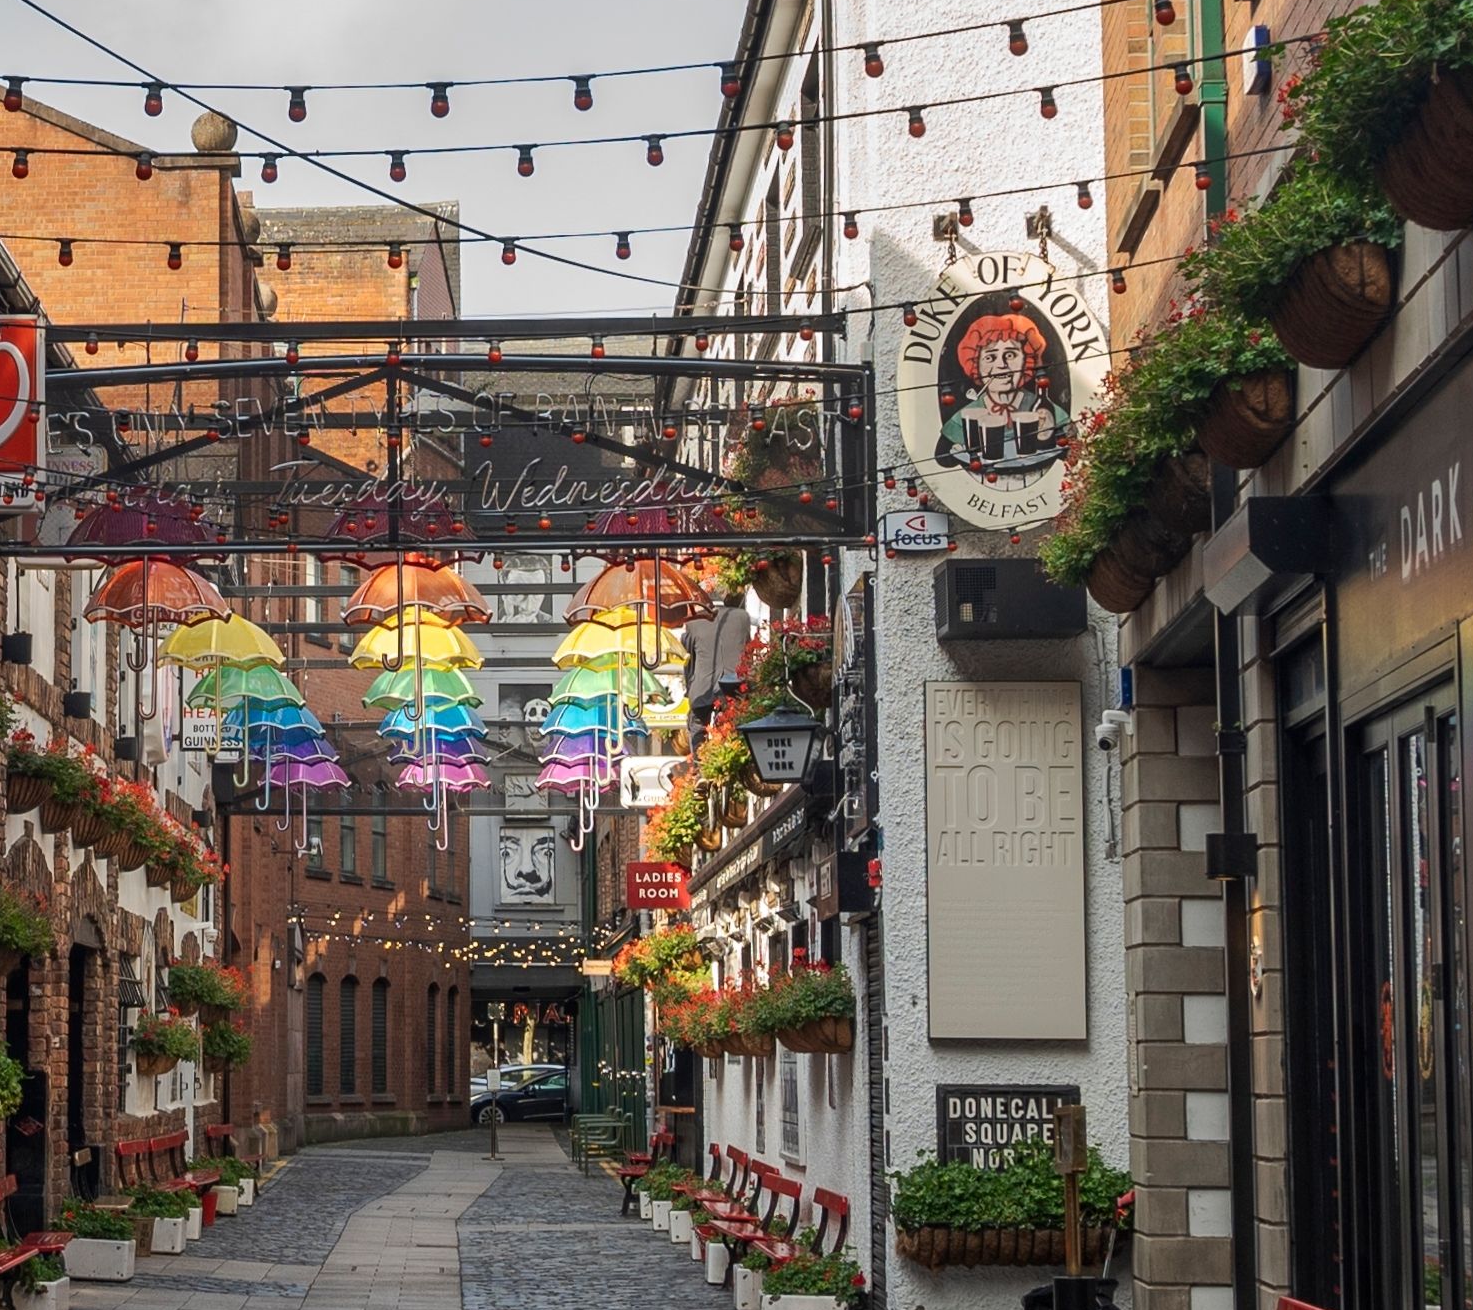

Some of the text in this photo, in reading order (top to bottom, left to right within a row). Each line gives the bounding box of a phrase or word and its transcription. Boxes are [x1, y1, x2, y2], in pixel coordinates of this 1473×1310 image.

[903, 255, 1104, 365] DUKE OF YORK
[214, 395, 325, 437] SEVEN
[473, 392, 514, 433] OF
[684, 400, 840, 451] BELAST
[967, 493, 1049, 518] BELFAST
[1400, 461, 1462, 582] DARK
[895, 528, 942, 546] focus
[193, 725, 231, 733] BOTTED
[184, 737, 241, 746] GUINNESS
[767, 738, 792, 748] DUKE
[774, 750, 786, 759] OF
[767, 761, 794, 771] YORK
[635, 873, 682, 883] LADIES
[639, 889, 680, 898] ROOM
[948, 1097, 1061, 1119] DONEGAL
